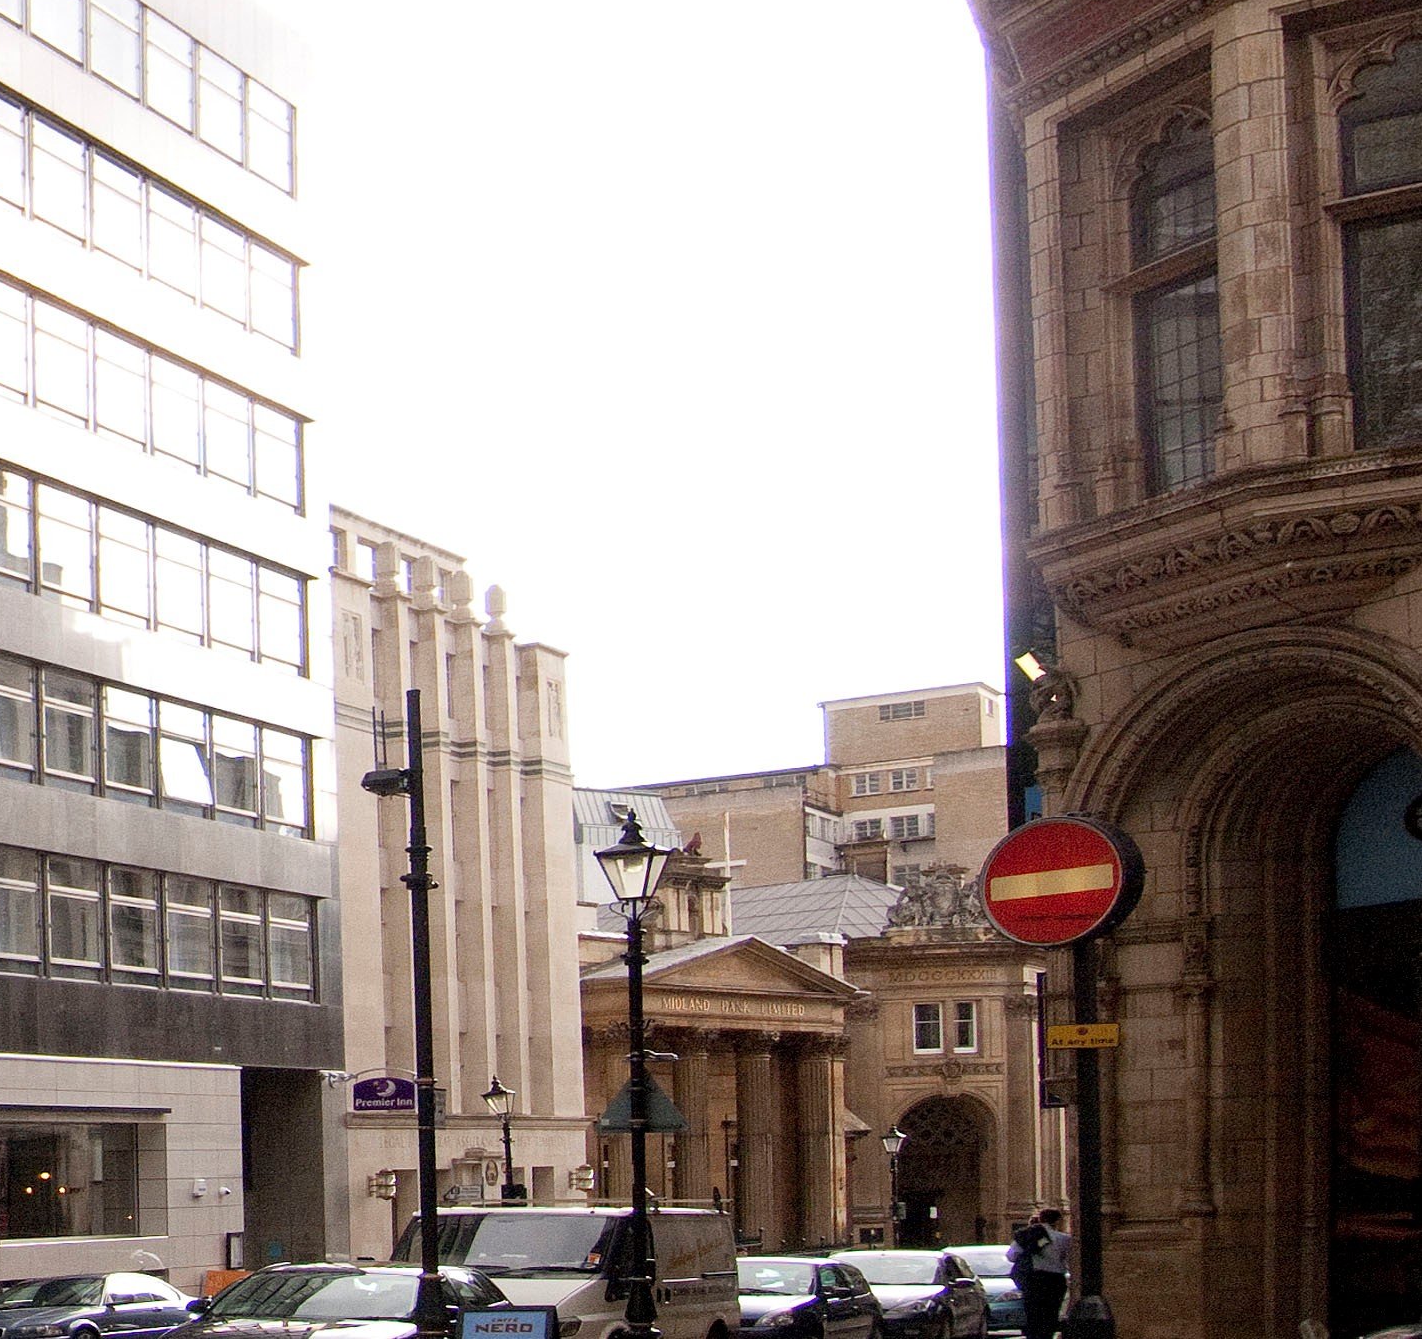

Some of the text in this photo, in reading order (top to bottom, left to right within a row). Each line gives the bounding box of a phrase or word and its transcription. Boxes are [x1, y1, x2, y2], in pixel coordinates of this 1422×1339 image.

[661, 997, 805, 1016] MIDLAND BANK LIMITED
[355, 1097, 413, 1107] Premier Inn
[475, 1323, 533, 1333] NERO
